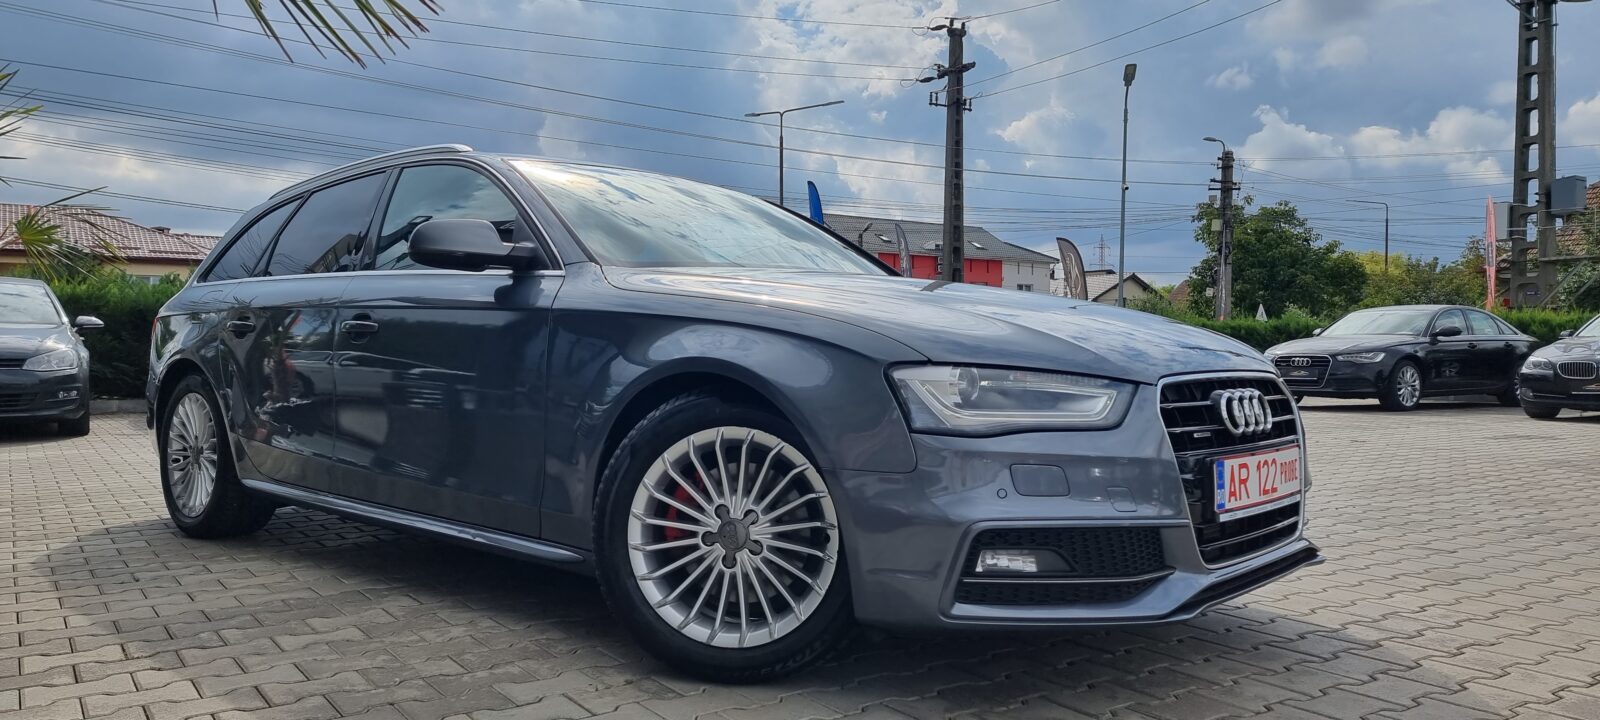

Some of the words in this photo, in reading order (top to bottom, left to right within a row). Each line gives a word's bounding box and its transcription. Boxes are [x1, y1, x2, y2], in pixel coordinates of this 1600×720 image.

[1228, 463, 1250, 503] AR
[1257, 458, 1278, 497] 122
[1280, 459, 1298, 485] PROBE
